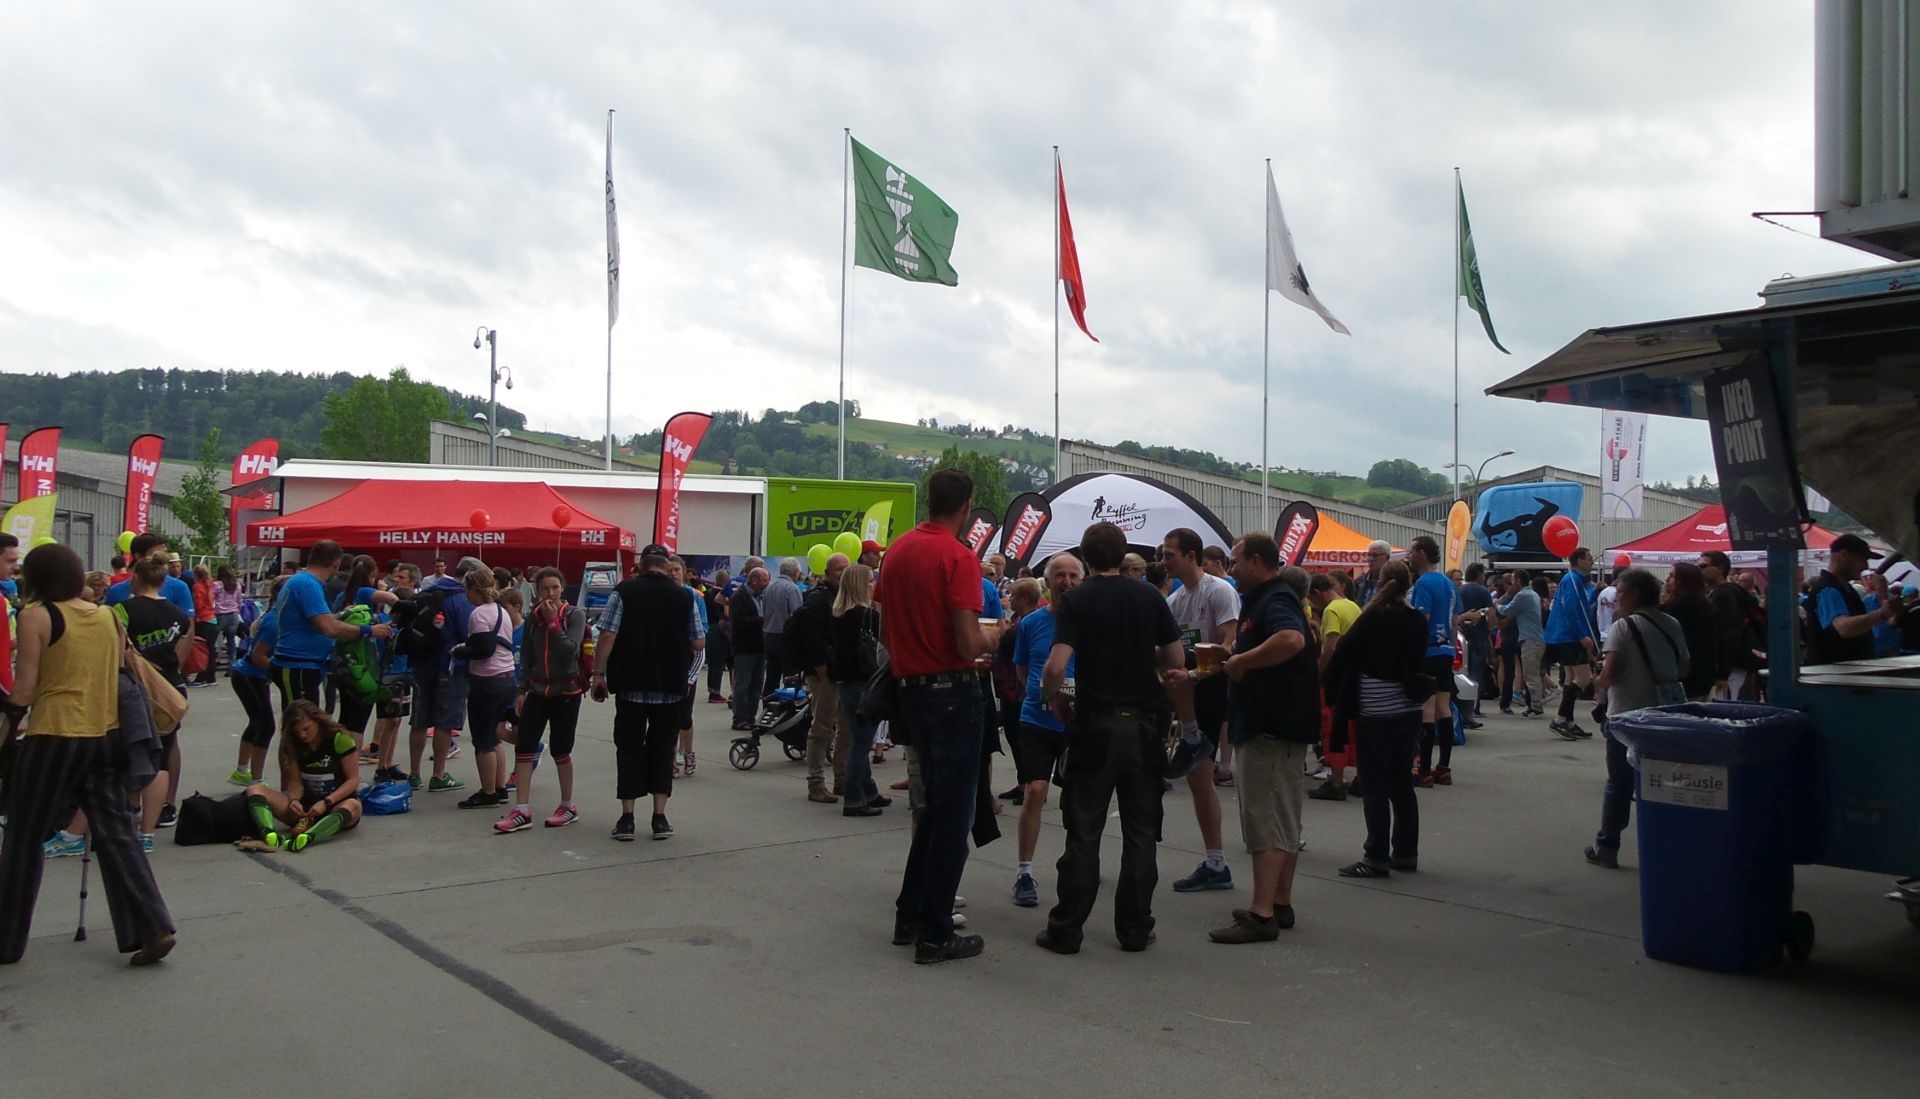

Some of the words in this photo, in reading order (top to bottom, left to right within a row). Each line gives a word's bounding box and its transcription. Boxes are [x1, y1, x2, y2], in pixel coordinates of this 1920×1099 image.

[1721, 378, 1755, 423] INFO
[663, 434, 693, 462] HH
[1723, 419, 1766, 464] POINT
[22, 455, 54, 473] HH
[131, 456, 157, 477] HH
[137, 482, 150, 536] ANSEN
[258, 526, 285, 540] HH
[380, 532, 431, 544] HELLY
[436, 531, 505, 544] HANSEN
[581, 530, 605, 542] HH
[1004, 504, 1045, 560] SPORTXX
[1672, 771, 1723, 790] Häusle
